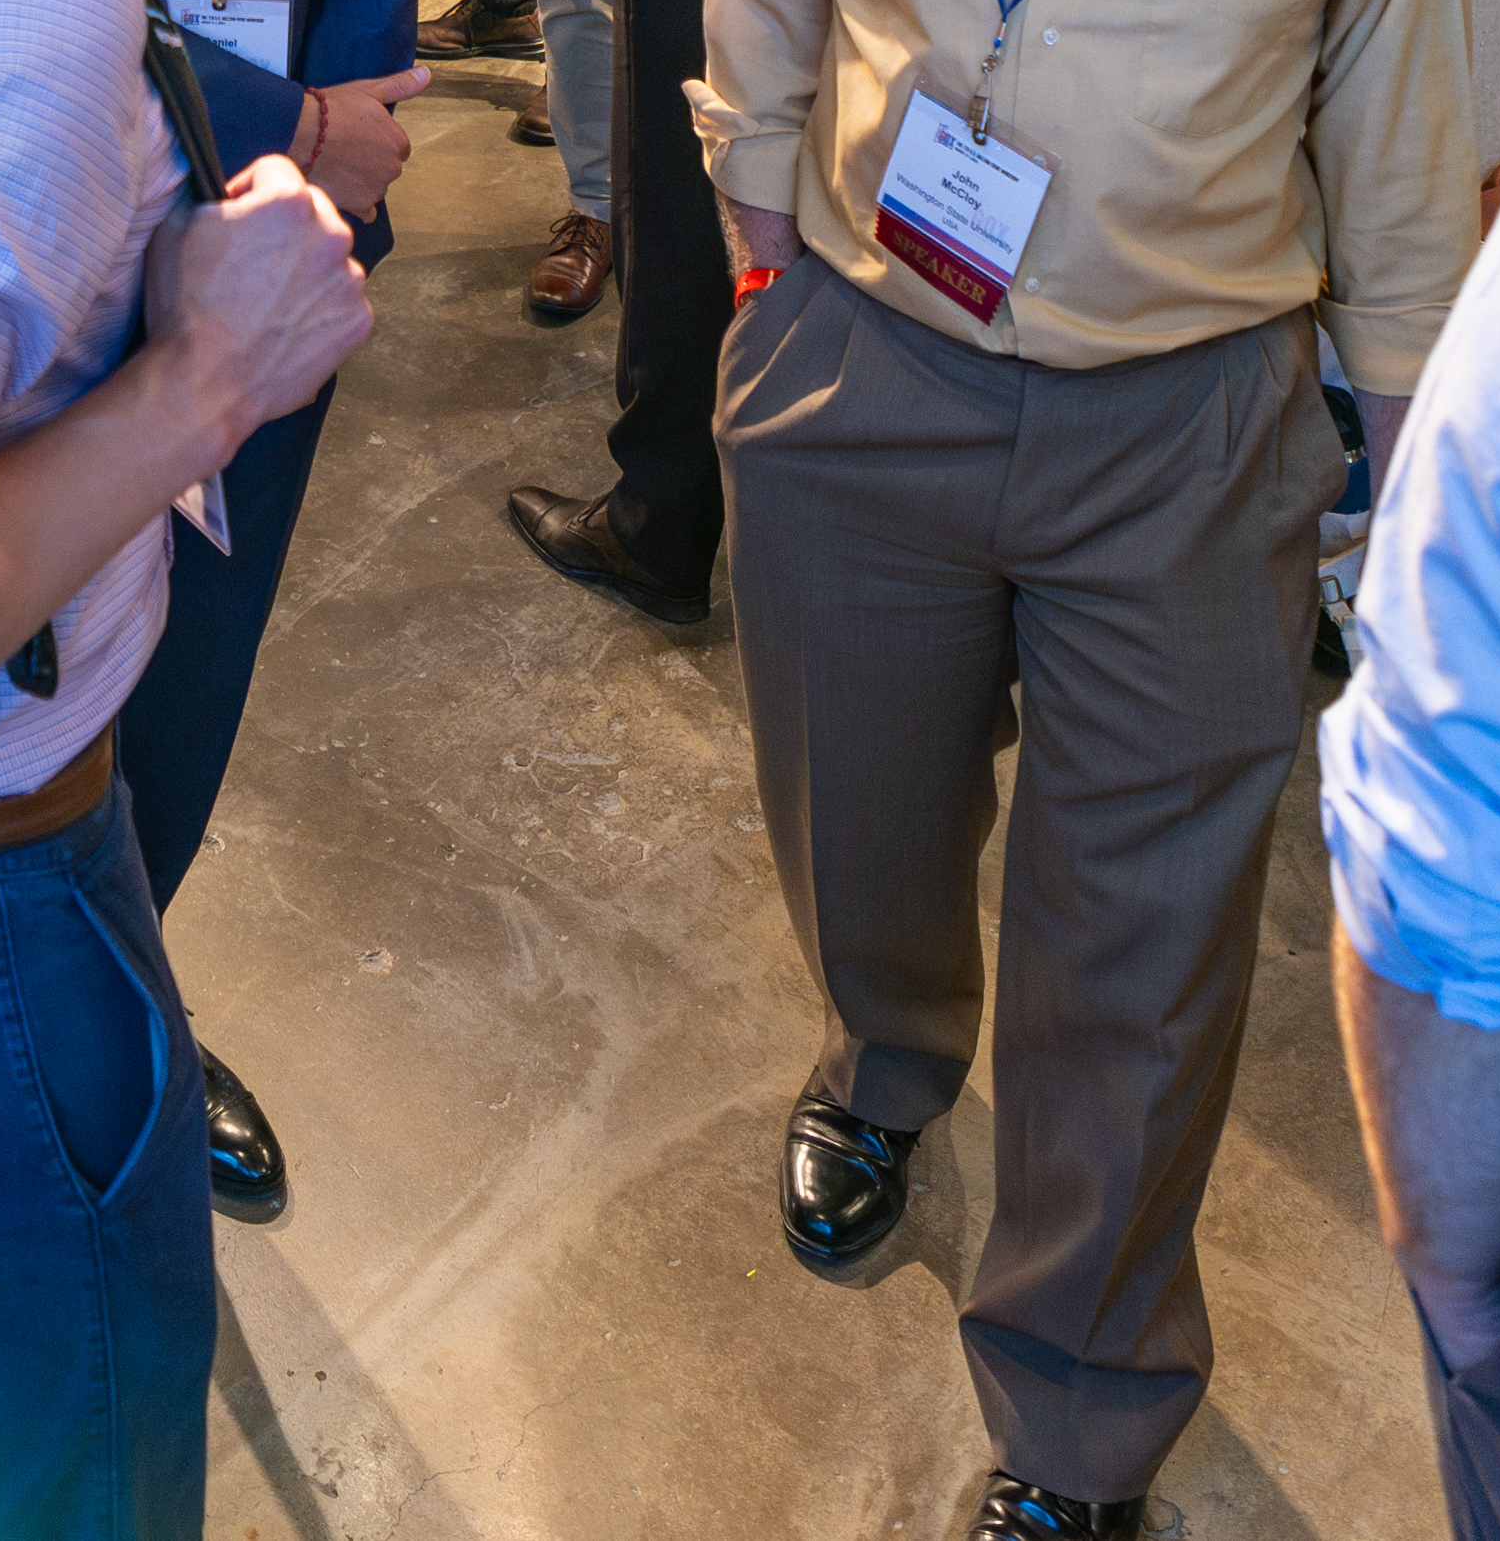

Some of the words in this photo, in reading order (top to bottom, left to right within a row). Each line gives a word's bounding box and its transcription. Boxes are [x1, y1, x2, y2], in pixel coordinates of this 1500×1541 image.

[183, 13, 200, 23] GOX
[213, 38, 238, 48] aniel
[952, 170, 980, 193] John
[896, 172, 945, 210] Washington
[945, 205, 969, 226] State
[970, 219, 1014, 255] University
[942, 215, 959, 232] USA
[893, 228, 988, 306] SPEAKER
